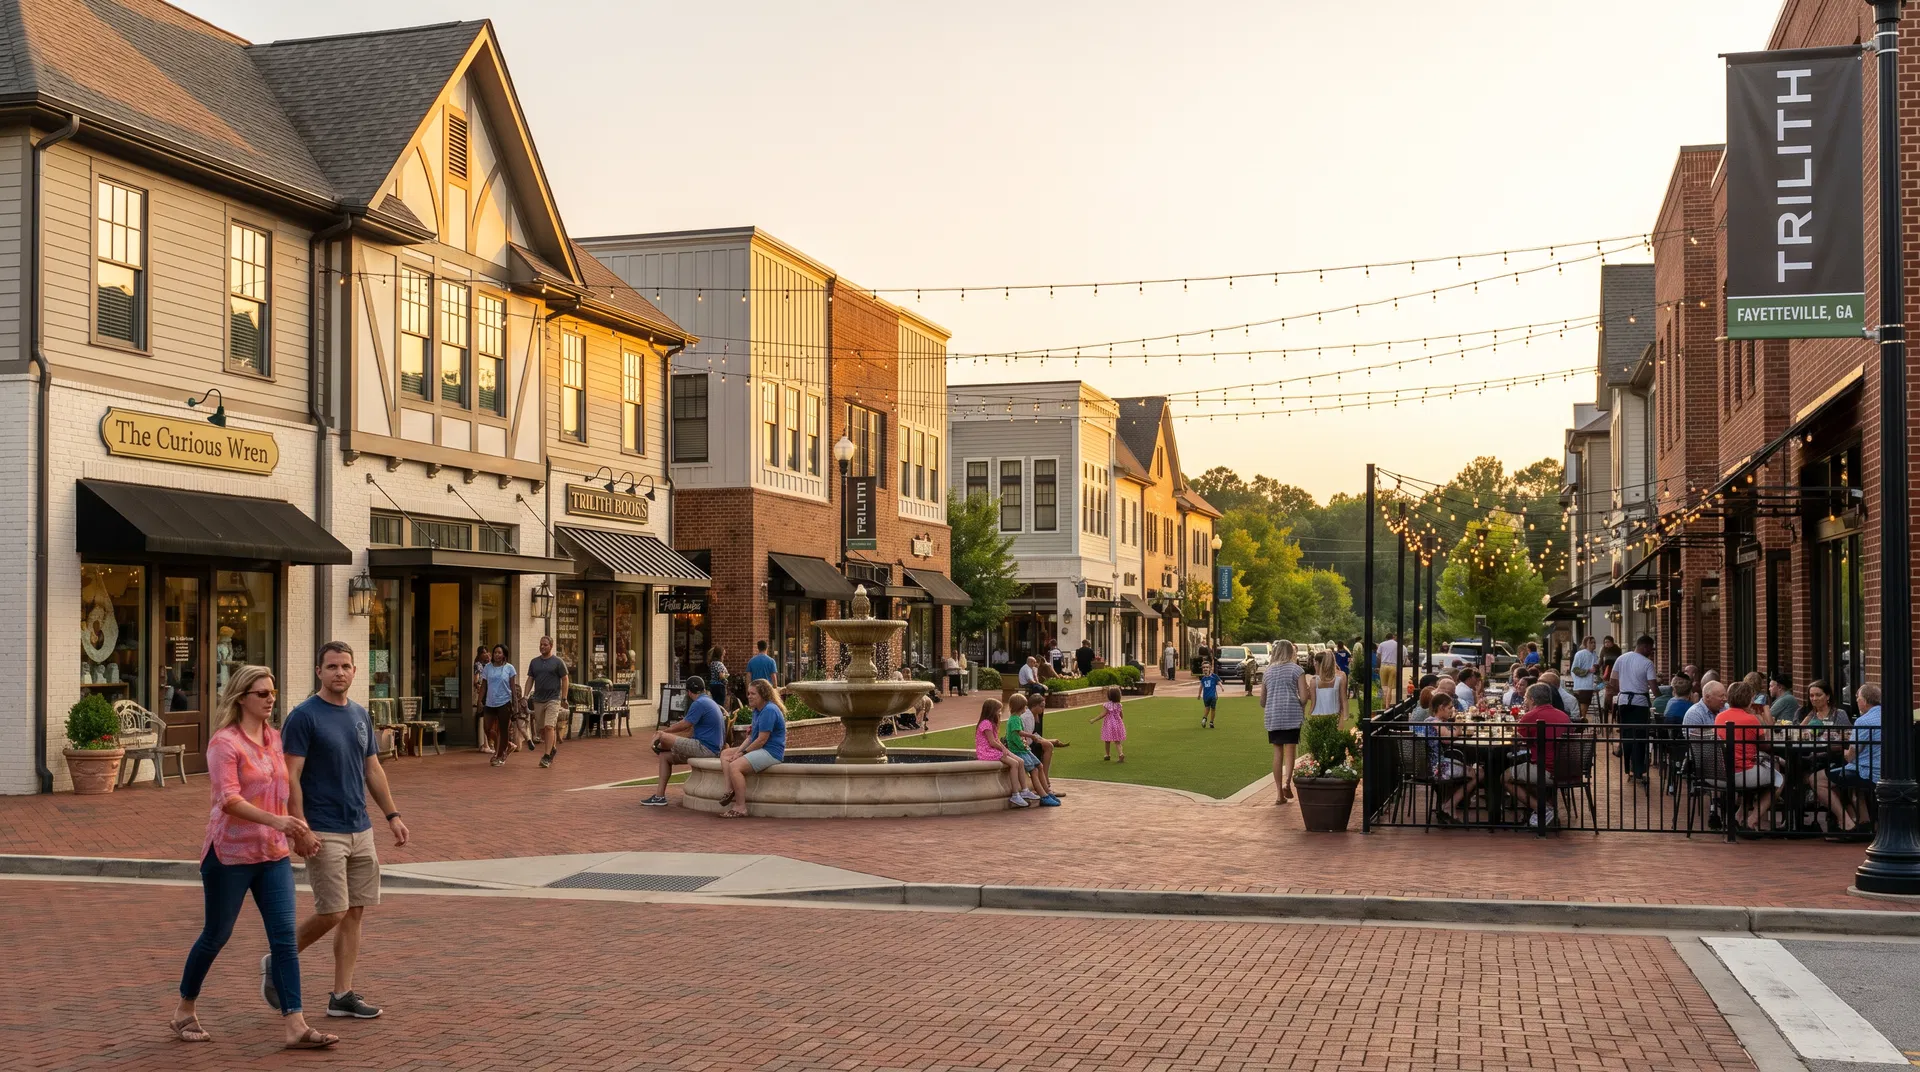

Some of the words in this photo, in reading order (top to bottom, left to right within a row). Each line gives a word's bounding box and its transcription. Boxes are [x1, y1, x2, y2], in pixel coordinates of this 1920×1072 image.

[1776, 68, 1813, 283] TRILITH
[1737, 305, 1831, 322] FAYETTEVILLE,
[1836, 304, 1853, 319] GA
[115, 419, 151, 447] The
[156, 426, 222, 456] Curious
[227, 436, 269, 464] Wren
[571, 492, 613, 513] TRILITH
[614, 499, 647, 518] BOOKS
